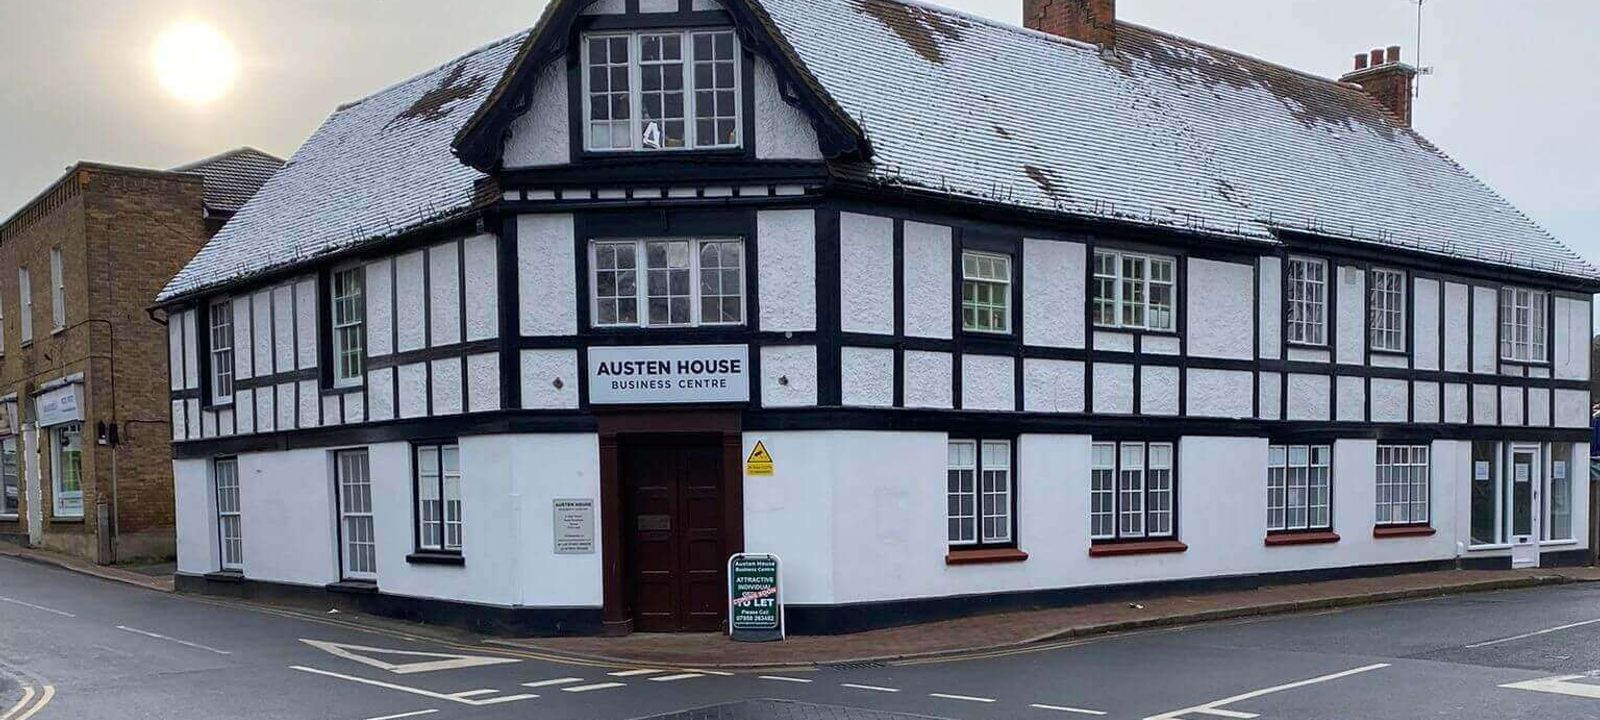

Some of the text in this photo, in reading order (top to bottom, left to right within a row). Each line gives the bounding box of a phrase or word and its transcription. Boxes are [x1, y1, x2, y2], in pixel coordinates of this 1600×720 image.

[597, 359, 741, 376] AUSTEN HOUSE
[612, 379, 726, 389] BUSINESS CENTRE
[754, 598, 774, 607] LET
